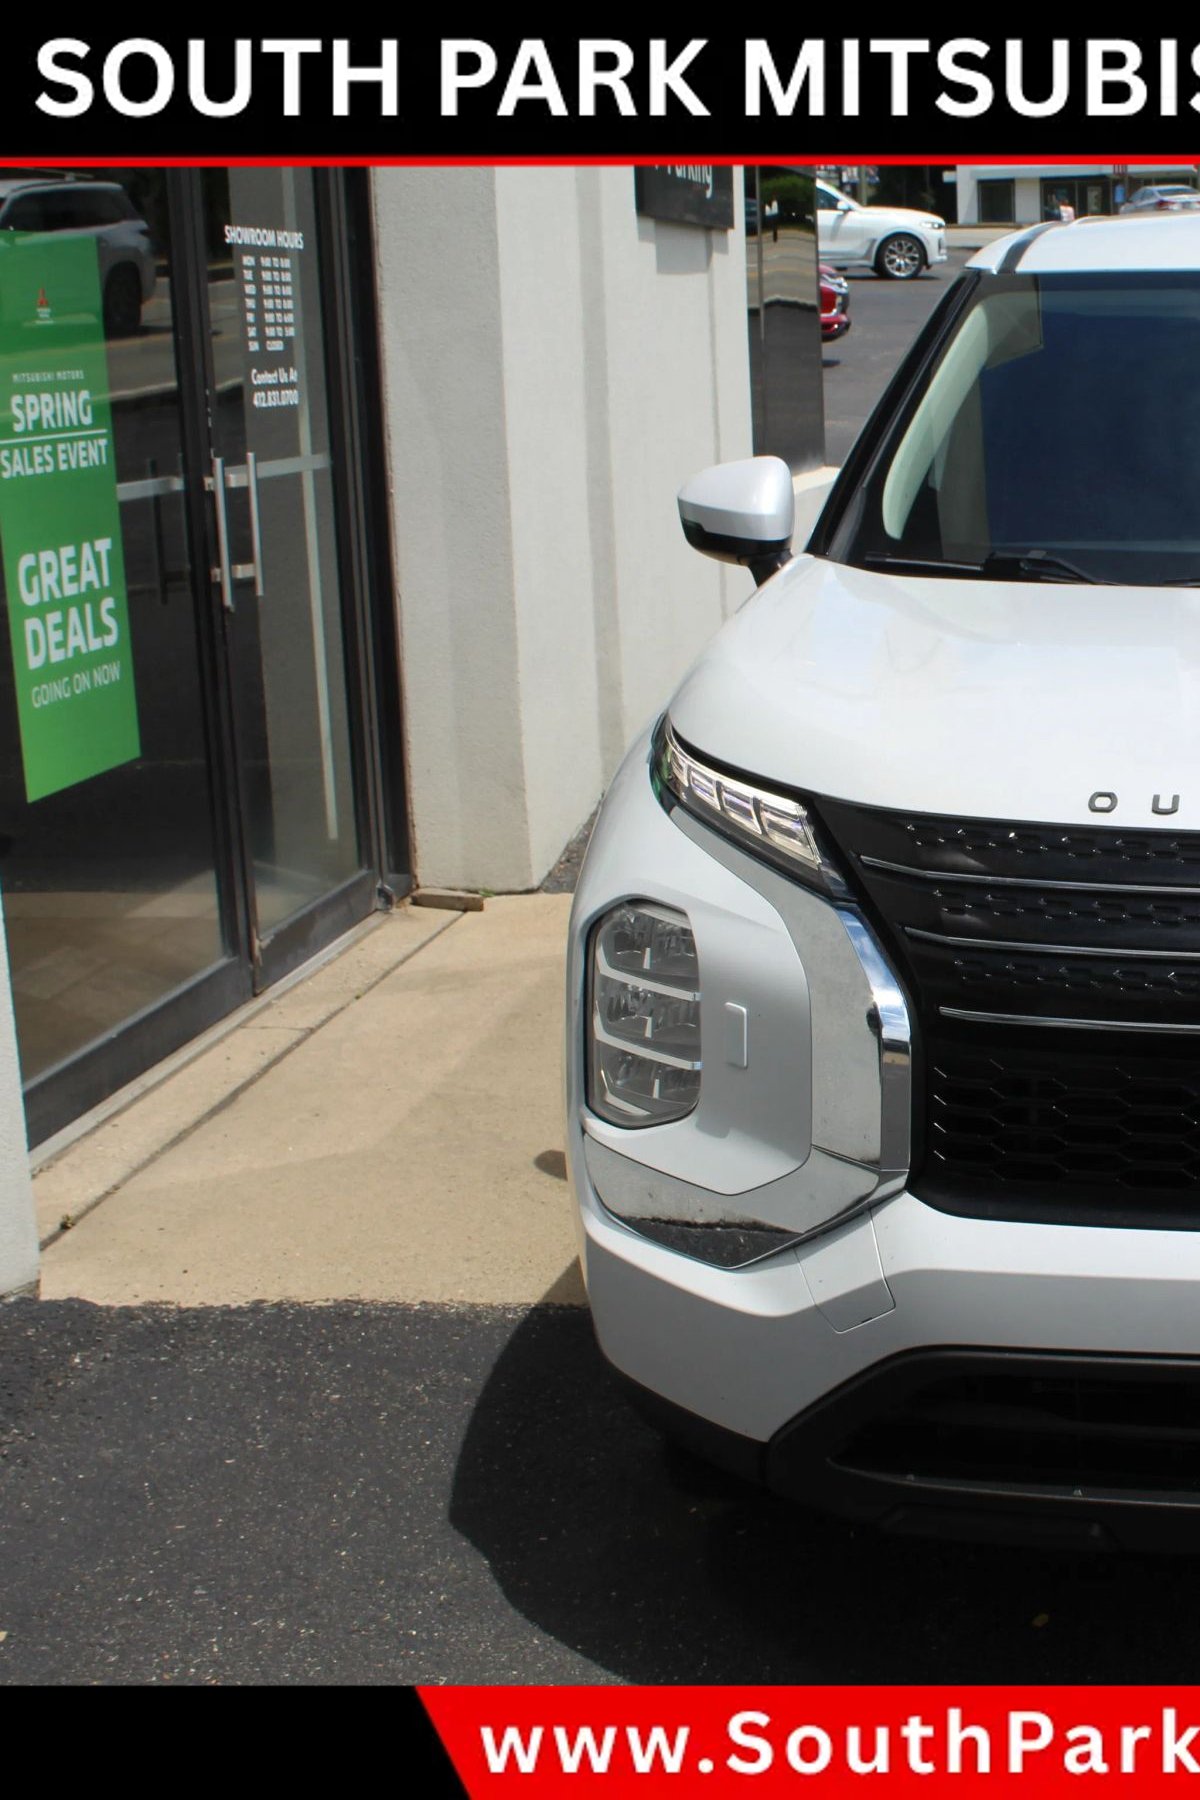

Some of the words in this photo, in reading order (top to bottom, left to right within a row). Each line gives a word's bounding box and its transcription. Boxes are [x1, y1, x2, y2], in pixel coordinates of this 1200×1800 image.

[224, 225, 276, 247] SHOWROOM
[276, 230, 304, 249] HOURS
[56, 370, 84, 380] MOTORS
[251, 368, 278, 385] Contact
[278, 367, 288, 383] Us
[11, 390, 93, 433] SPRING
[0, 445, 55, 479] SALES
[57, 438, 108, 471] EVENT
[18, 538, 113, 607] GREAT
[24, 597, 119, 671] DEALS
[31, 676, 71, 708] GOING
[72, 670, 91, 695] ON
[93, 660, 121, 687] NOW
